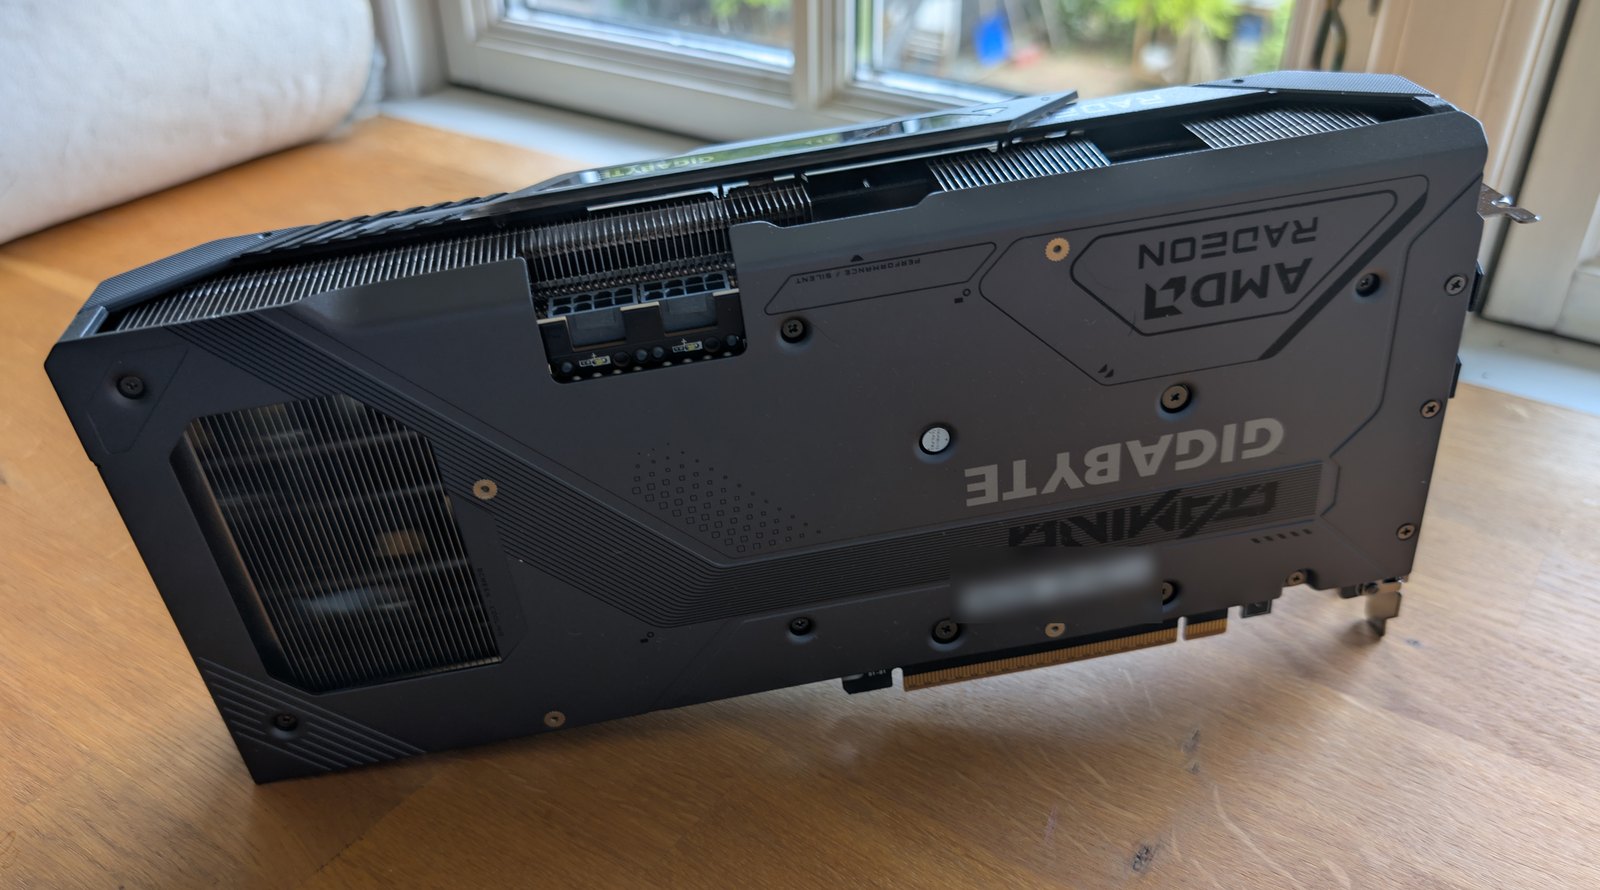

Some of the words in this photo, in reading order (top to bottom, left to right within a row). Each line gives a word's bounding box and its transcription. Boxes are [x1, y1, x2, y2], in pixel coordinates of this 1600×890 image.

[845, 258, 921, 276] PERFORMANCE
[1138, 216, 1319, 270] RADEON
[796, 273, 832, 285] SILENT
[1190, 257, 1313, 308] AMD
[963, 417, 1285, 507] GIGABYTE
